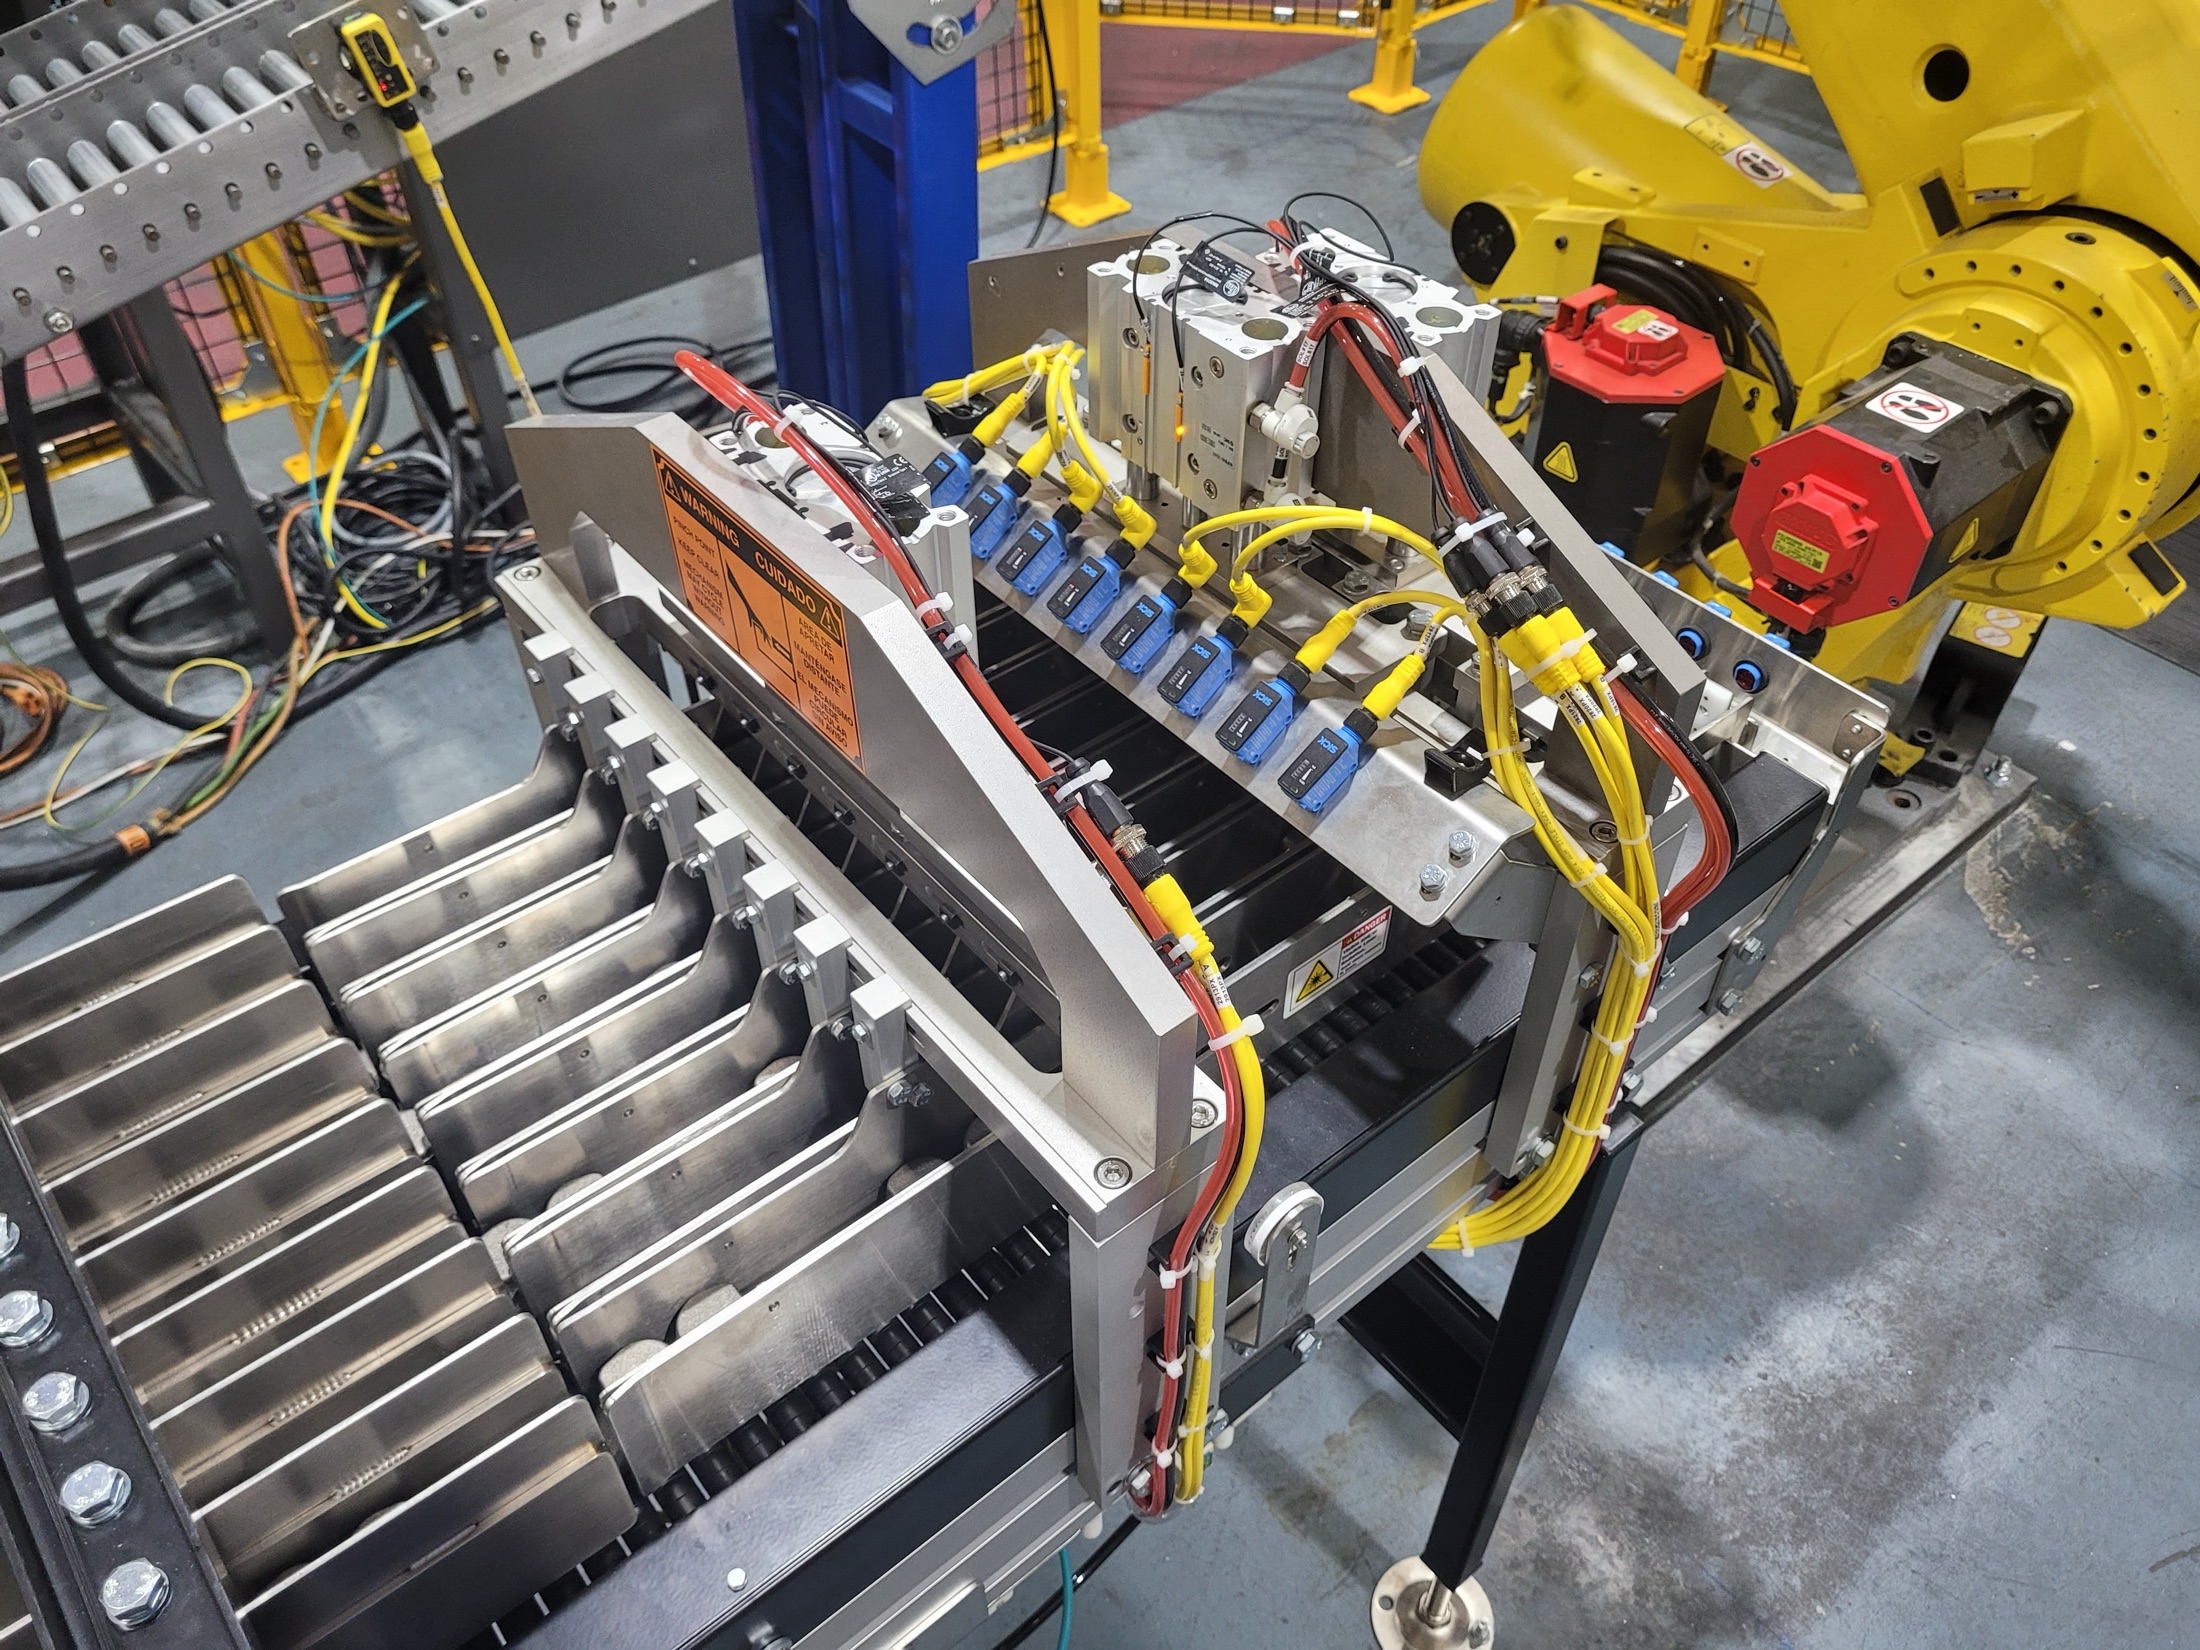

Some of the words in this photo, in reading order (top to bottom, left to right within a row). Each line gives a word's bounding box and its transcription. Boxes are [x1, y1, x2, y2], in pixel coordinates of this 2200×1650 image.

[672, 514, 694, 540] PINCH
[694, 533, 716, 560] POINT
[679, 484, 740, 550] WARNING
[753, 548, 817, 616] CUIDADO
[677, 536, 696, 559] KEEP
[696, 553, 719, 580] CLEAR
[1081, 563, 1099, 578] SICK
[682, 557, 723, 601] MECHANISM
[1137, 602, 1155, 618] SICK
[797, 615, 818, 641] AREA
[819, 634, 832, 653] DE
[798, 625, 834, 664] APRETAR
[1192, 643, 1211, 659] SICK
[802, 657, 840, 698] DISTANTE
[796, 669, 807, 685] EL
[807, 679, 853, 728] MECANISMO
[813, 693, 839, 724] PUEDE
[1253, 689, 1273, 707] SICK
[808, 698, 847, 740] CIRCULAR
[825, 722, 848, 749] AVISO
[1317, 735, 1338, 755] SICK
[1549, 828, 1564, 847] STYLE
[1354, 913, 1387, 939] DANGER
[1208, 978, 1223, 1005] 2913PX
